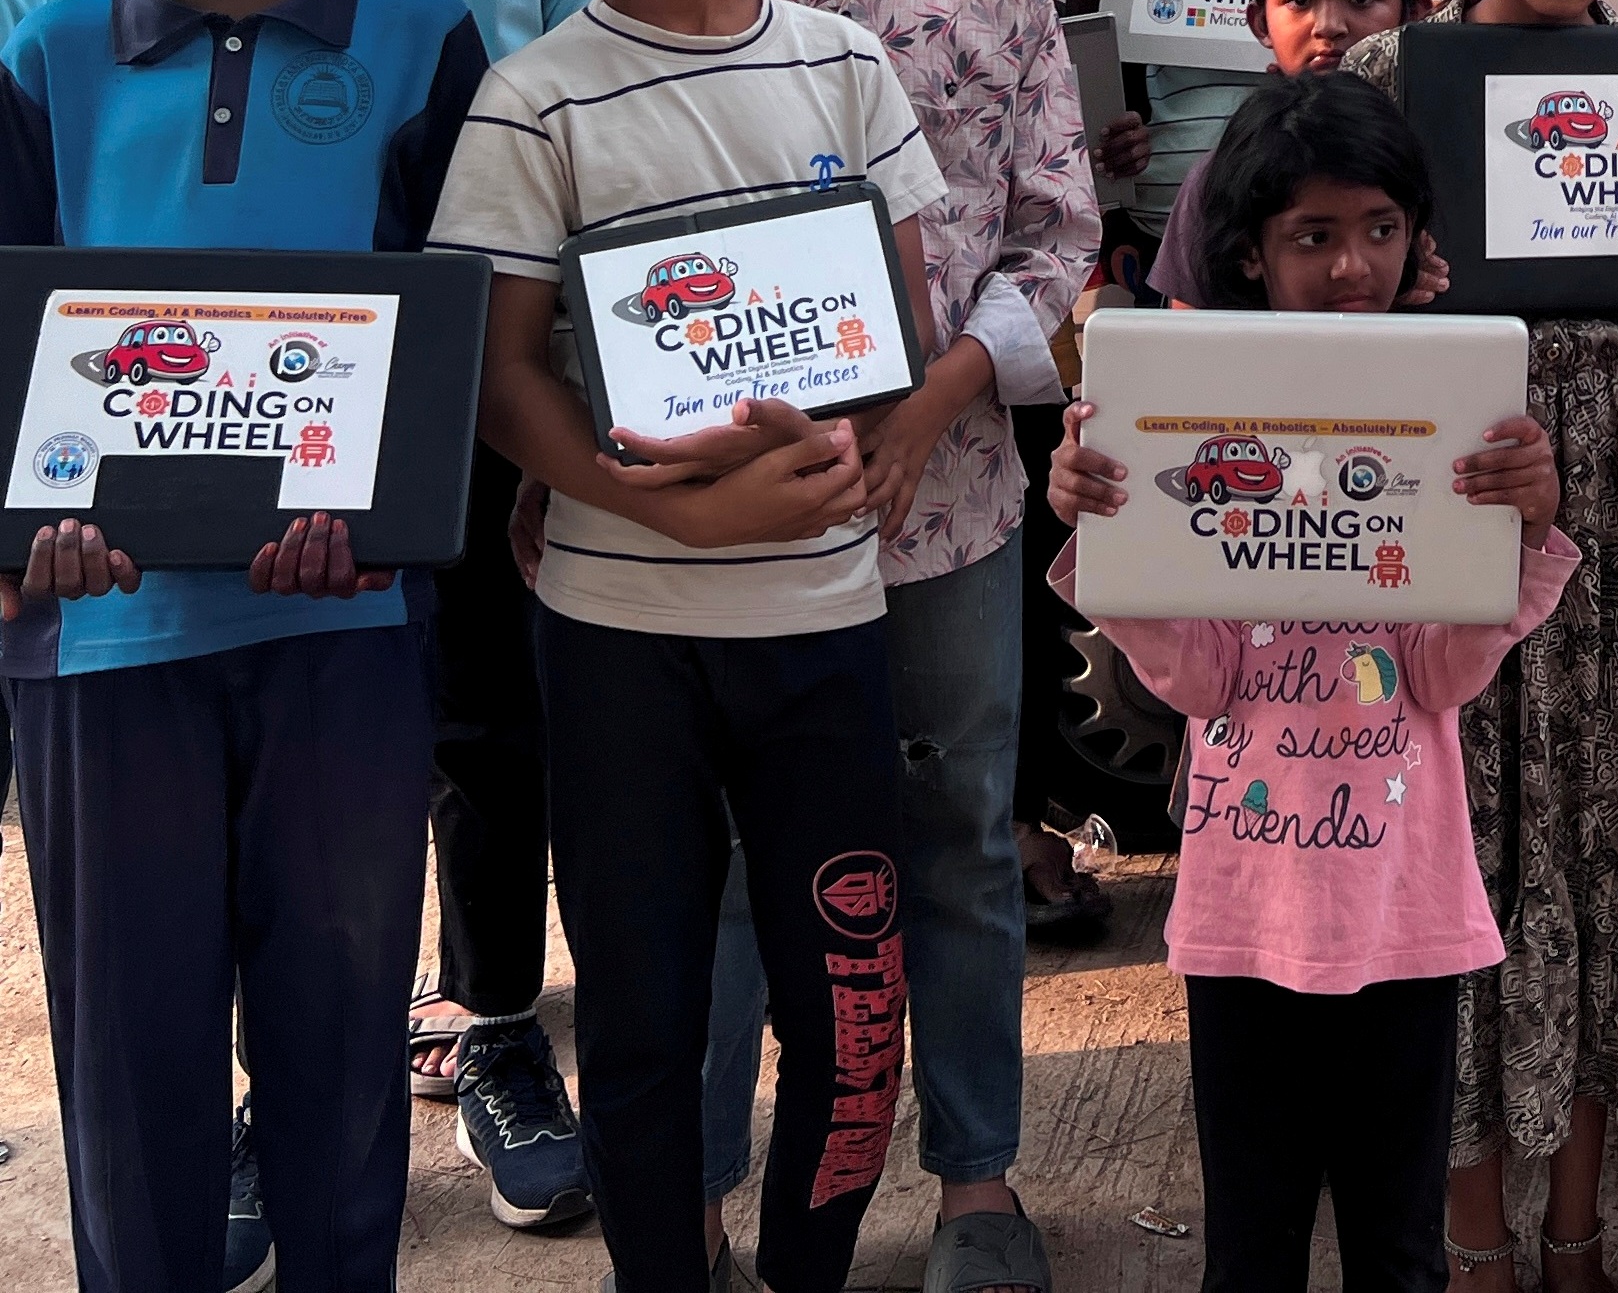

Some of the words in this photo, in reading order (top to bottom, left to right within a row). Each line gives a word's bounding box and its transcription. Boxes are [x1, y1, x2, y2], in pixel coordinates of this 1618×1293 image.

[1210, 13, 1248, 27] Micro
[1531, 219, 1565, 241] Join
[1571, 224, 1598, 239] our
[67, 306, 104, 315] Learn
[109, 306, 159, 318] Coding,
[163, 307, 177, 316] AI
[181, 308, 189, 316] &
[194, 308, 252, 319] Robotics
[268, 310, 336, 323] Absolutely
[340, 311, 367, 322] Free
[655, 296, 817, 351] CODING
[821, 292, 857, 313] ON
[689, 325, 836, 375] WHEEL
[103, 388, 286, 419] CODING
[293, 396, 334, 414] ON
[664, 395, 704, 420] Join
[713, 388, 744, 410] our
[798, 364, 859, 391] classes
[134, 421, 292, 450] WHEEL
[1144, 420, 1178, 430] Learn
[1182, 420, 1230, 433] Coding,
[1233, 421, 1246, 431] AI
[1250, 422, 1258, 431] &
[1262, 422, 1317, 432] Robotics
[1332, 423, 1397, 436] Absolutely
[1401, 424, 1427, 435] Free
[1189, 507, 1361, 539] CODING
[1366, 515, 1404, 533] ON
[1221, 542, 1370, 572] WHEEL
[1237, 646, 1339, 704] with
[1276, 701, 1410, 760] sweet
